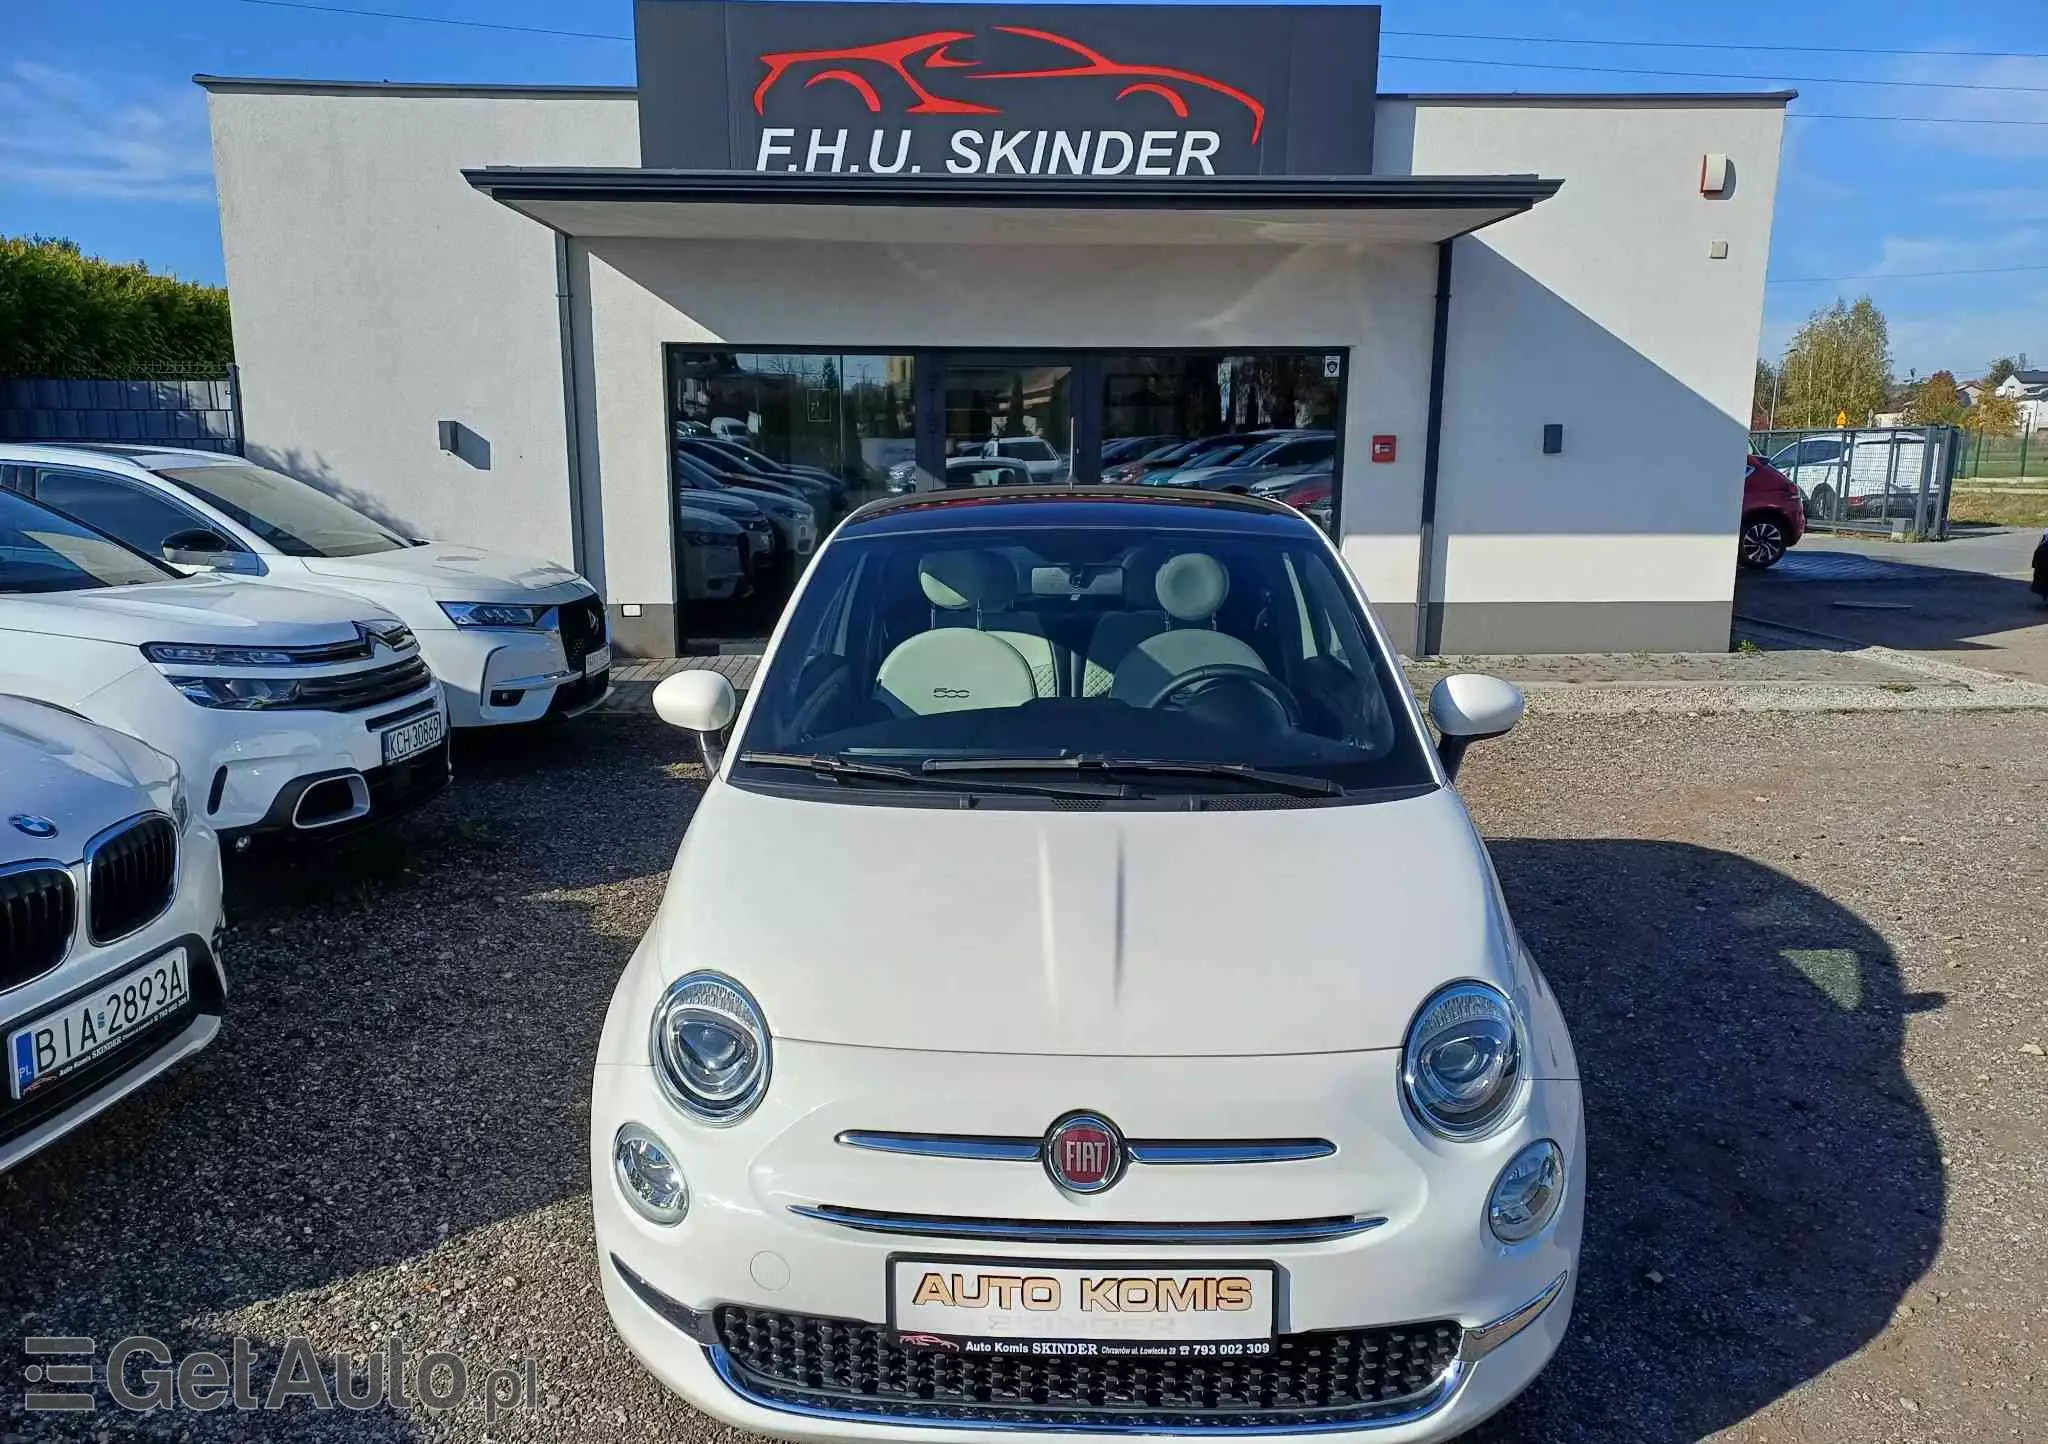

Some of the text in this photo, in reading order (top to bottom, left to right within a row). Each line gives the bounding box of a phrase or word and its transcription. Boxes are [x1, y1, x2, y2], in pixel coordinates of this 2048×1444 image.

[755, 127, 1221, 176] F.H.U. SKINDER
[389, 727, 411, 758] KCH
[413, 717, 439, 748] 30869
[35, 959, 183, 1074] BIA 2893A
[18, 1065, 33, 1080] PL
[1066, 1141, 1106, 1173] FIAT
[912, 1272, 1253, 1313] AUTO KOMIS
[965, 1341, 992, 1352] Auto
[994, 1341, 1029, 1353] Komis
[1032, 1342, 1098, 1355] SKINDER
[1193, 1345, 1217, 1356] 793
[1219, 1344, 1243, 1355] 002
[1246, 1343, 1270, 1354] 309
